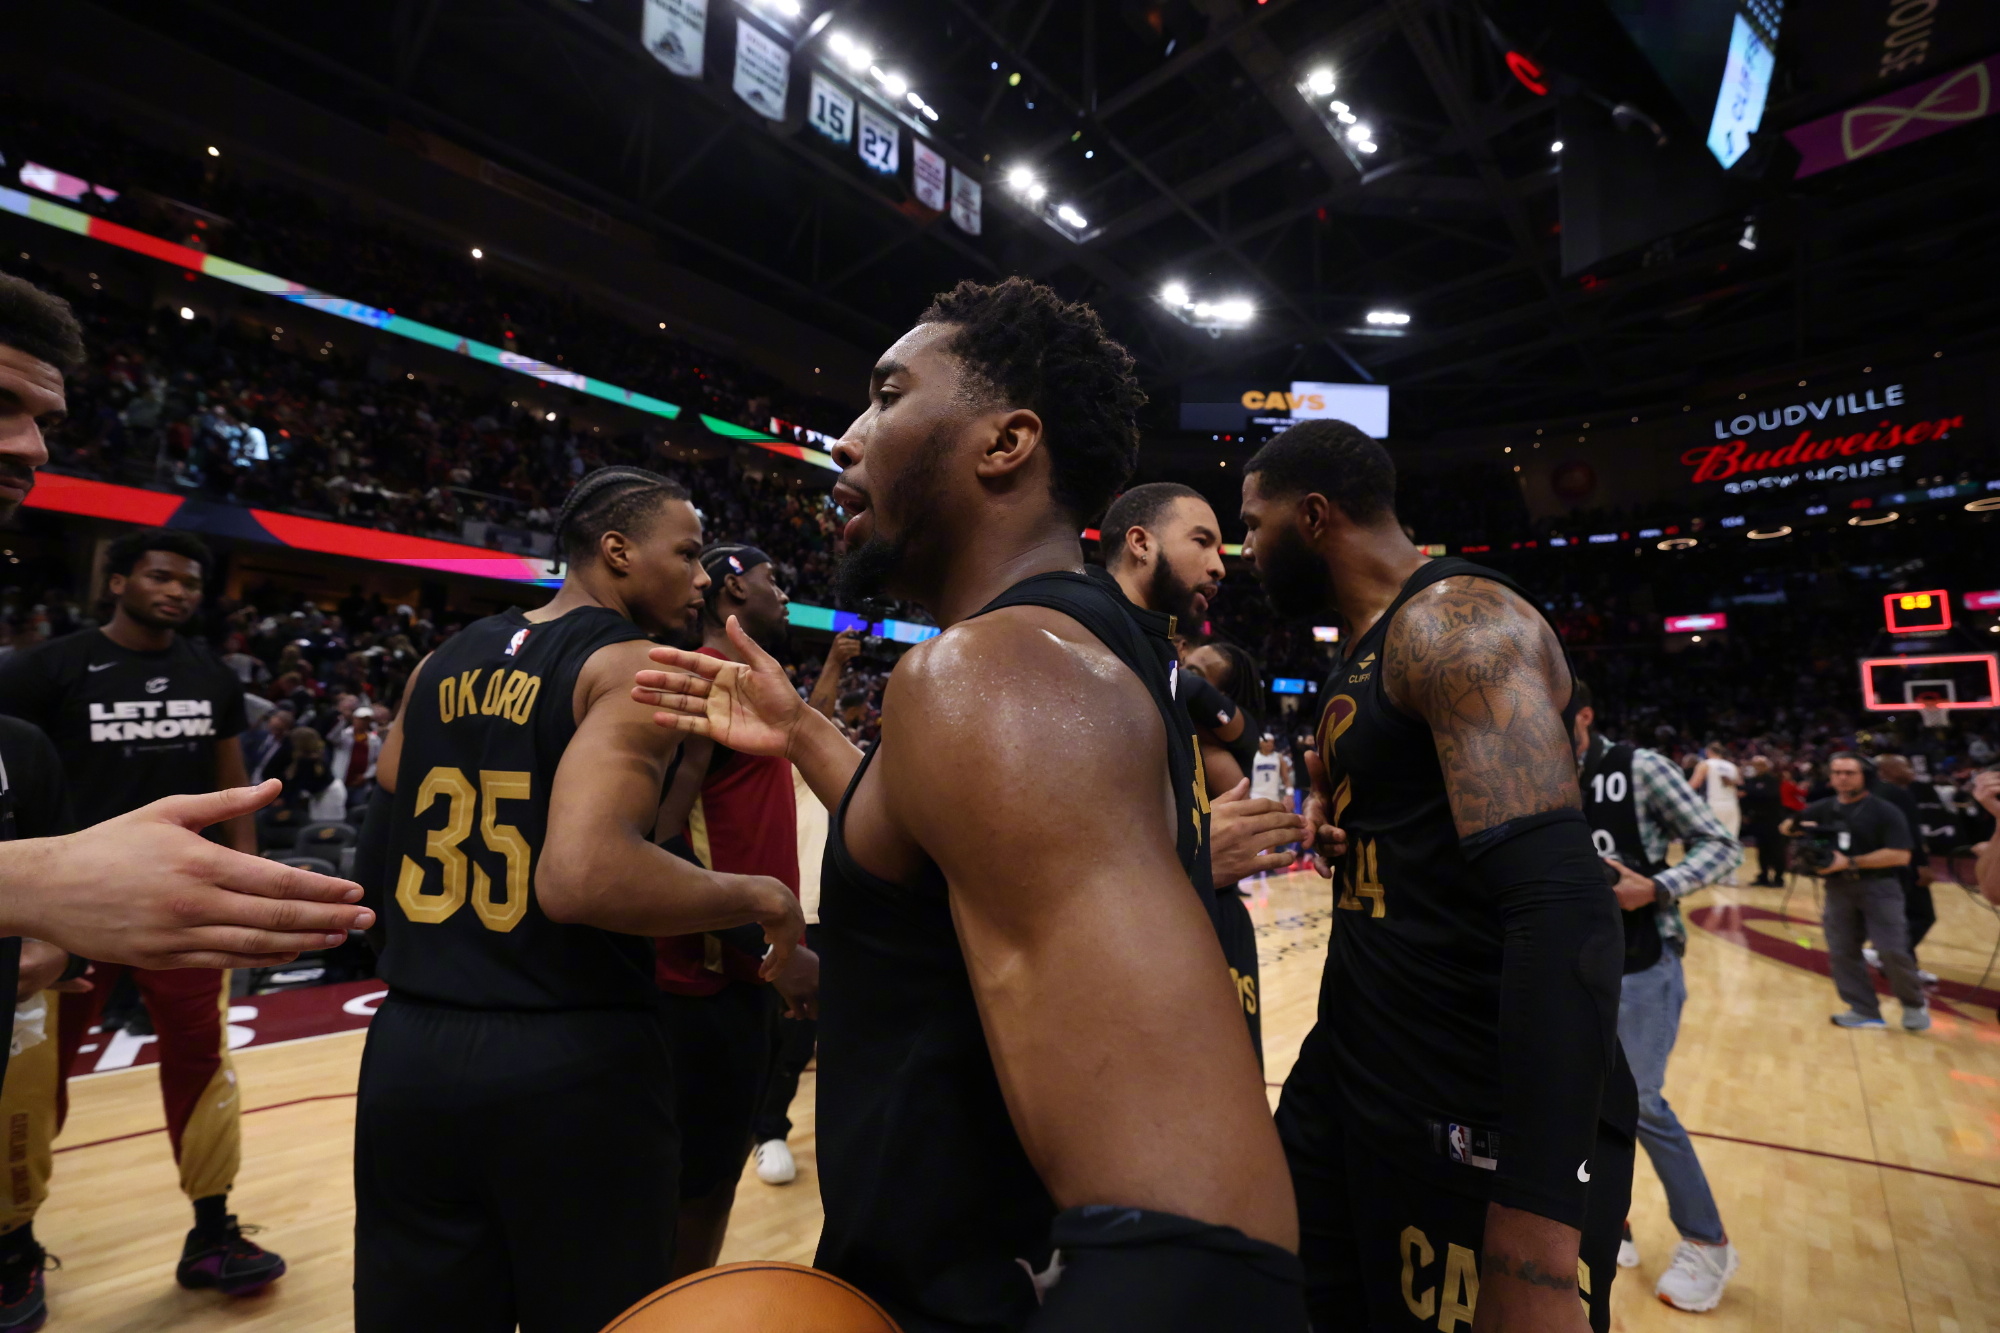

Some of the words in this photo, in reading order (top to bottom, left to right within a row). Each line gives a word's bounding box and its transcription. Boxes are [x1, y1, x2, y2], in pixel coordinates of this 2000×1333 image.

[817, 94, 844, 135] 15
[864, 127, 893, 165] 27
[1241, 390, 1326, 411] CAVS
[1715, 384, 1905, 440] LOUDVILLE
[1680, 415, 1965, 484] Budweiser
[89, 701, 163, 721] LET
[438, 668, 541, 726] OKORO
[90, 718, 216, 742] KNOW.
[1591, 771, 1628, 804] 10
[395, 766, 532, 933] 35
